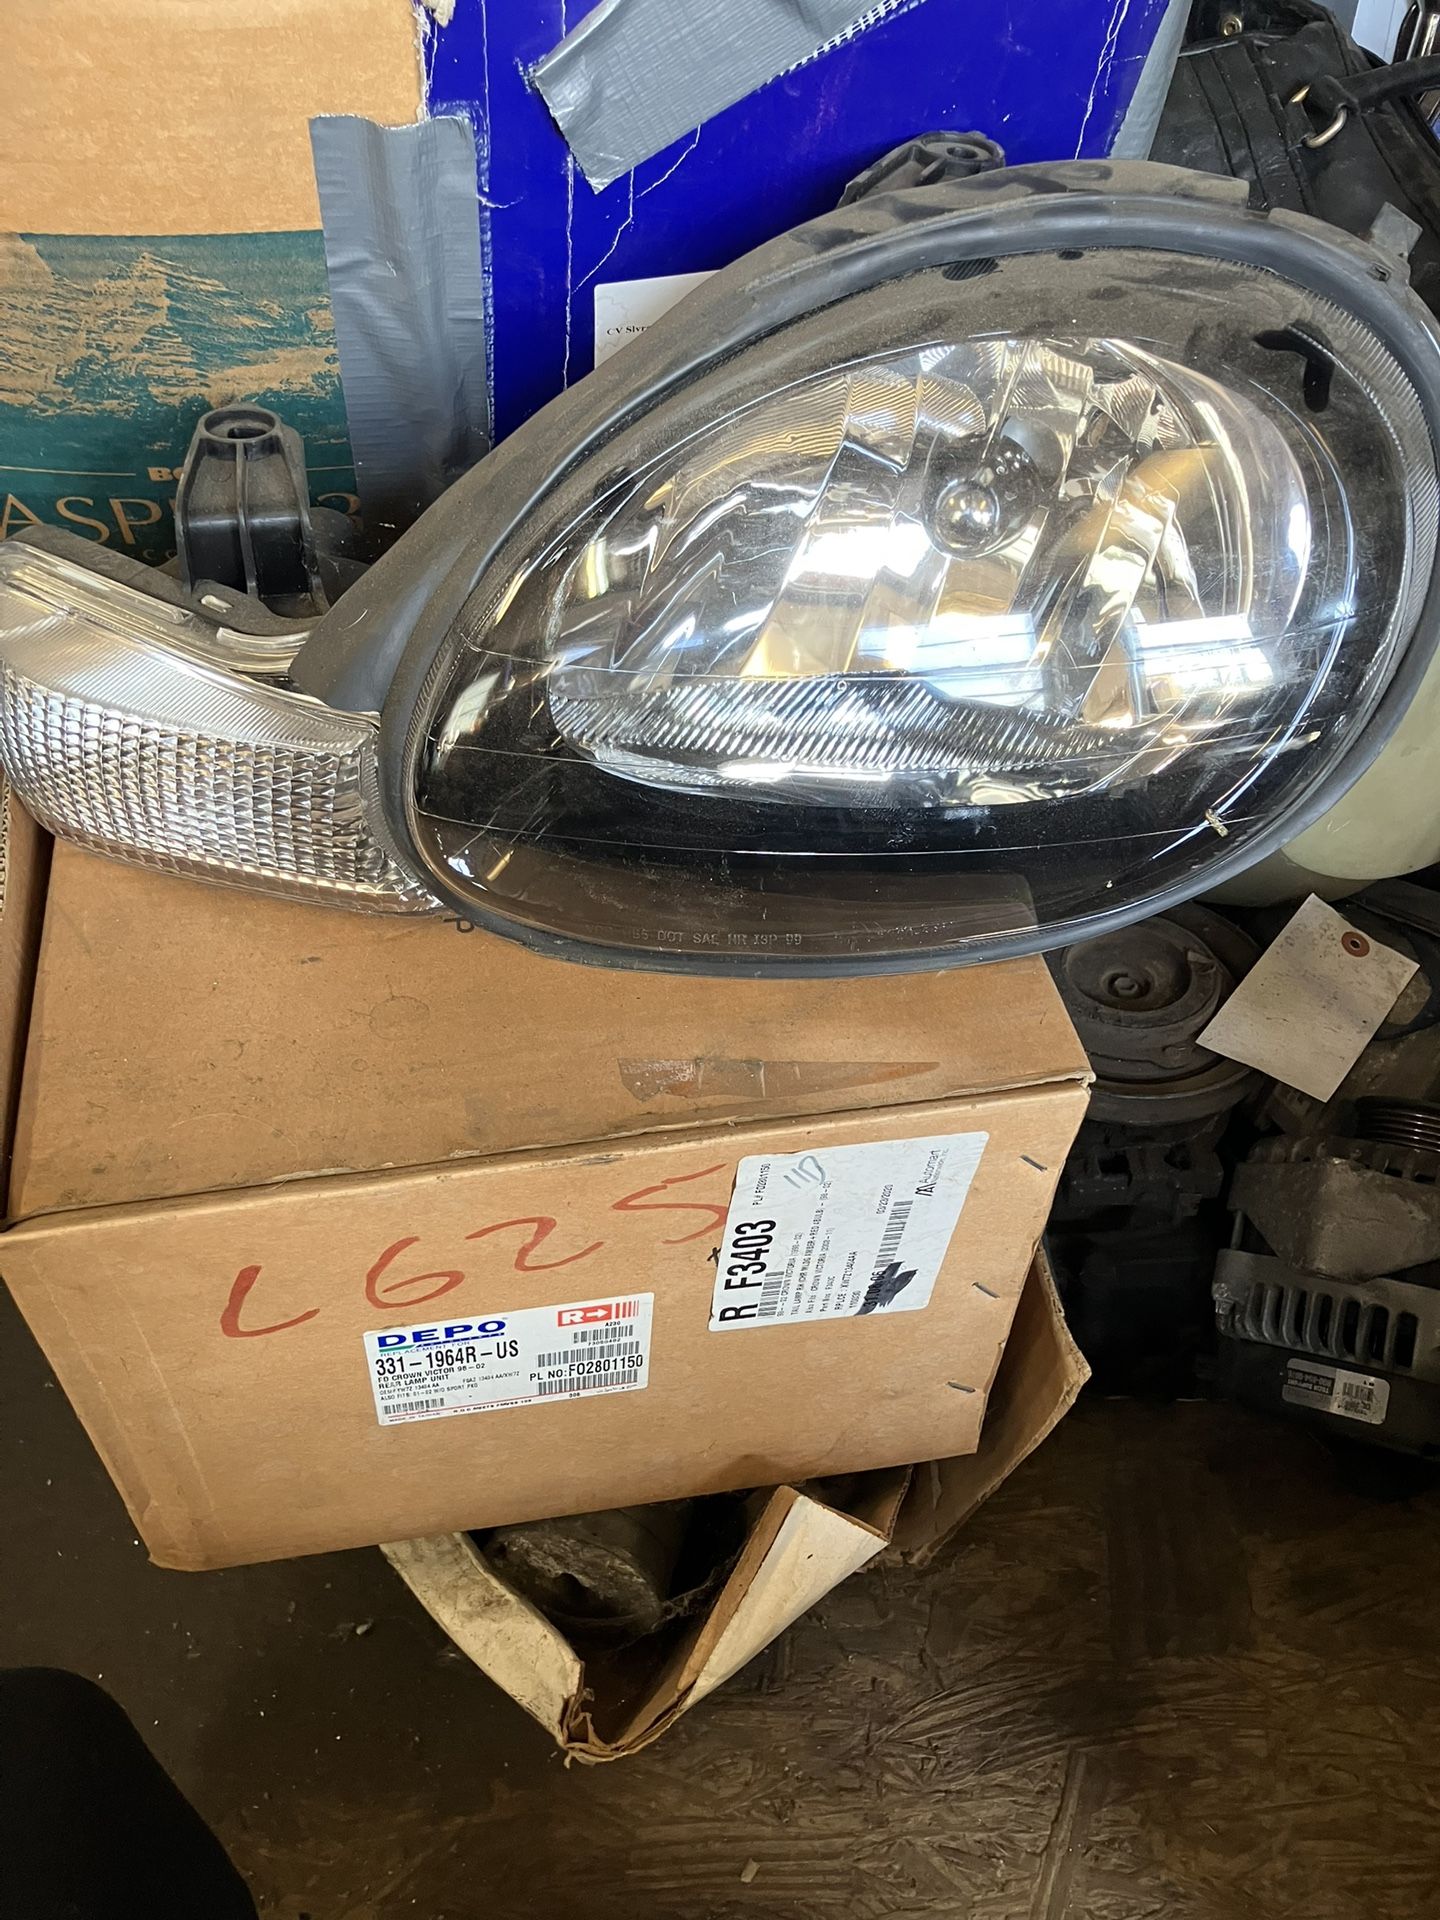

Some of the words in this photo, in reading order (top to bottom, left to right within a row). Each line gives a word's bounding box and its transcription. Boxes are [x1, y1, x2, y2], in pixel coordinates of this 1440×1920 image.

[625, 325, 649, 334] Slvr
[656, 930, 684, 943] DOT
[724, 1218, 776, 1290] F3403
[784, 1256, 795, 1278] VICTORIA
[814, 1252, 826, 1274] VICTORIA
[810, 1273, 821, 1291] CROWN
[561, 1309, 585, 1324] R
[719, 1303, 757, 1322] R
[790, 1304, 799, 1315] TAIL
[376, 1319, 506, 1347] DEPO
[379, 1344, 447, 1358] REPLACEMENT
[377, 1380, 402, 1390] REAR
[403, 1376, 428, 1386] LAMP
[429, 1373, 450, 1382] UNIT
[390, 1370, 424, 1382] CROWN
[424, 1366, 455, 1377] VICTOR
[528, 1370, 543, 1382] PL
[379, 1393, 396, 1401] ALSO
[446, 1384, 465, 1392] SPORT
